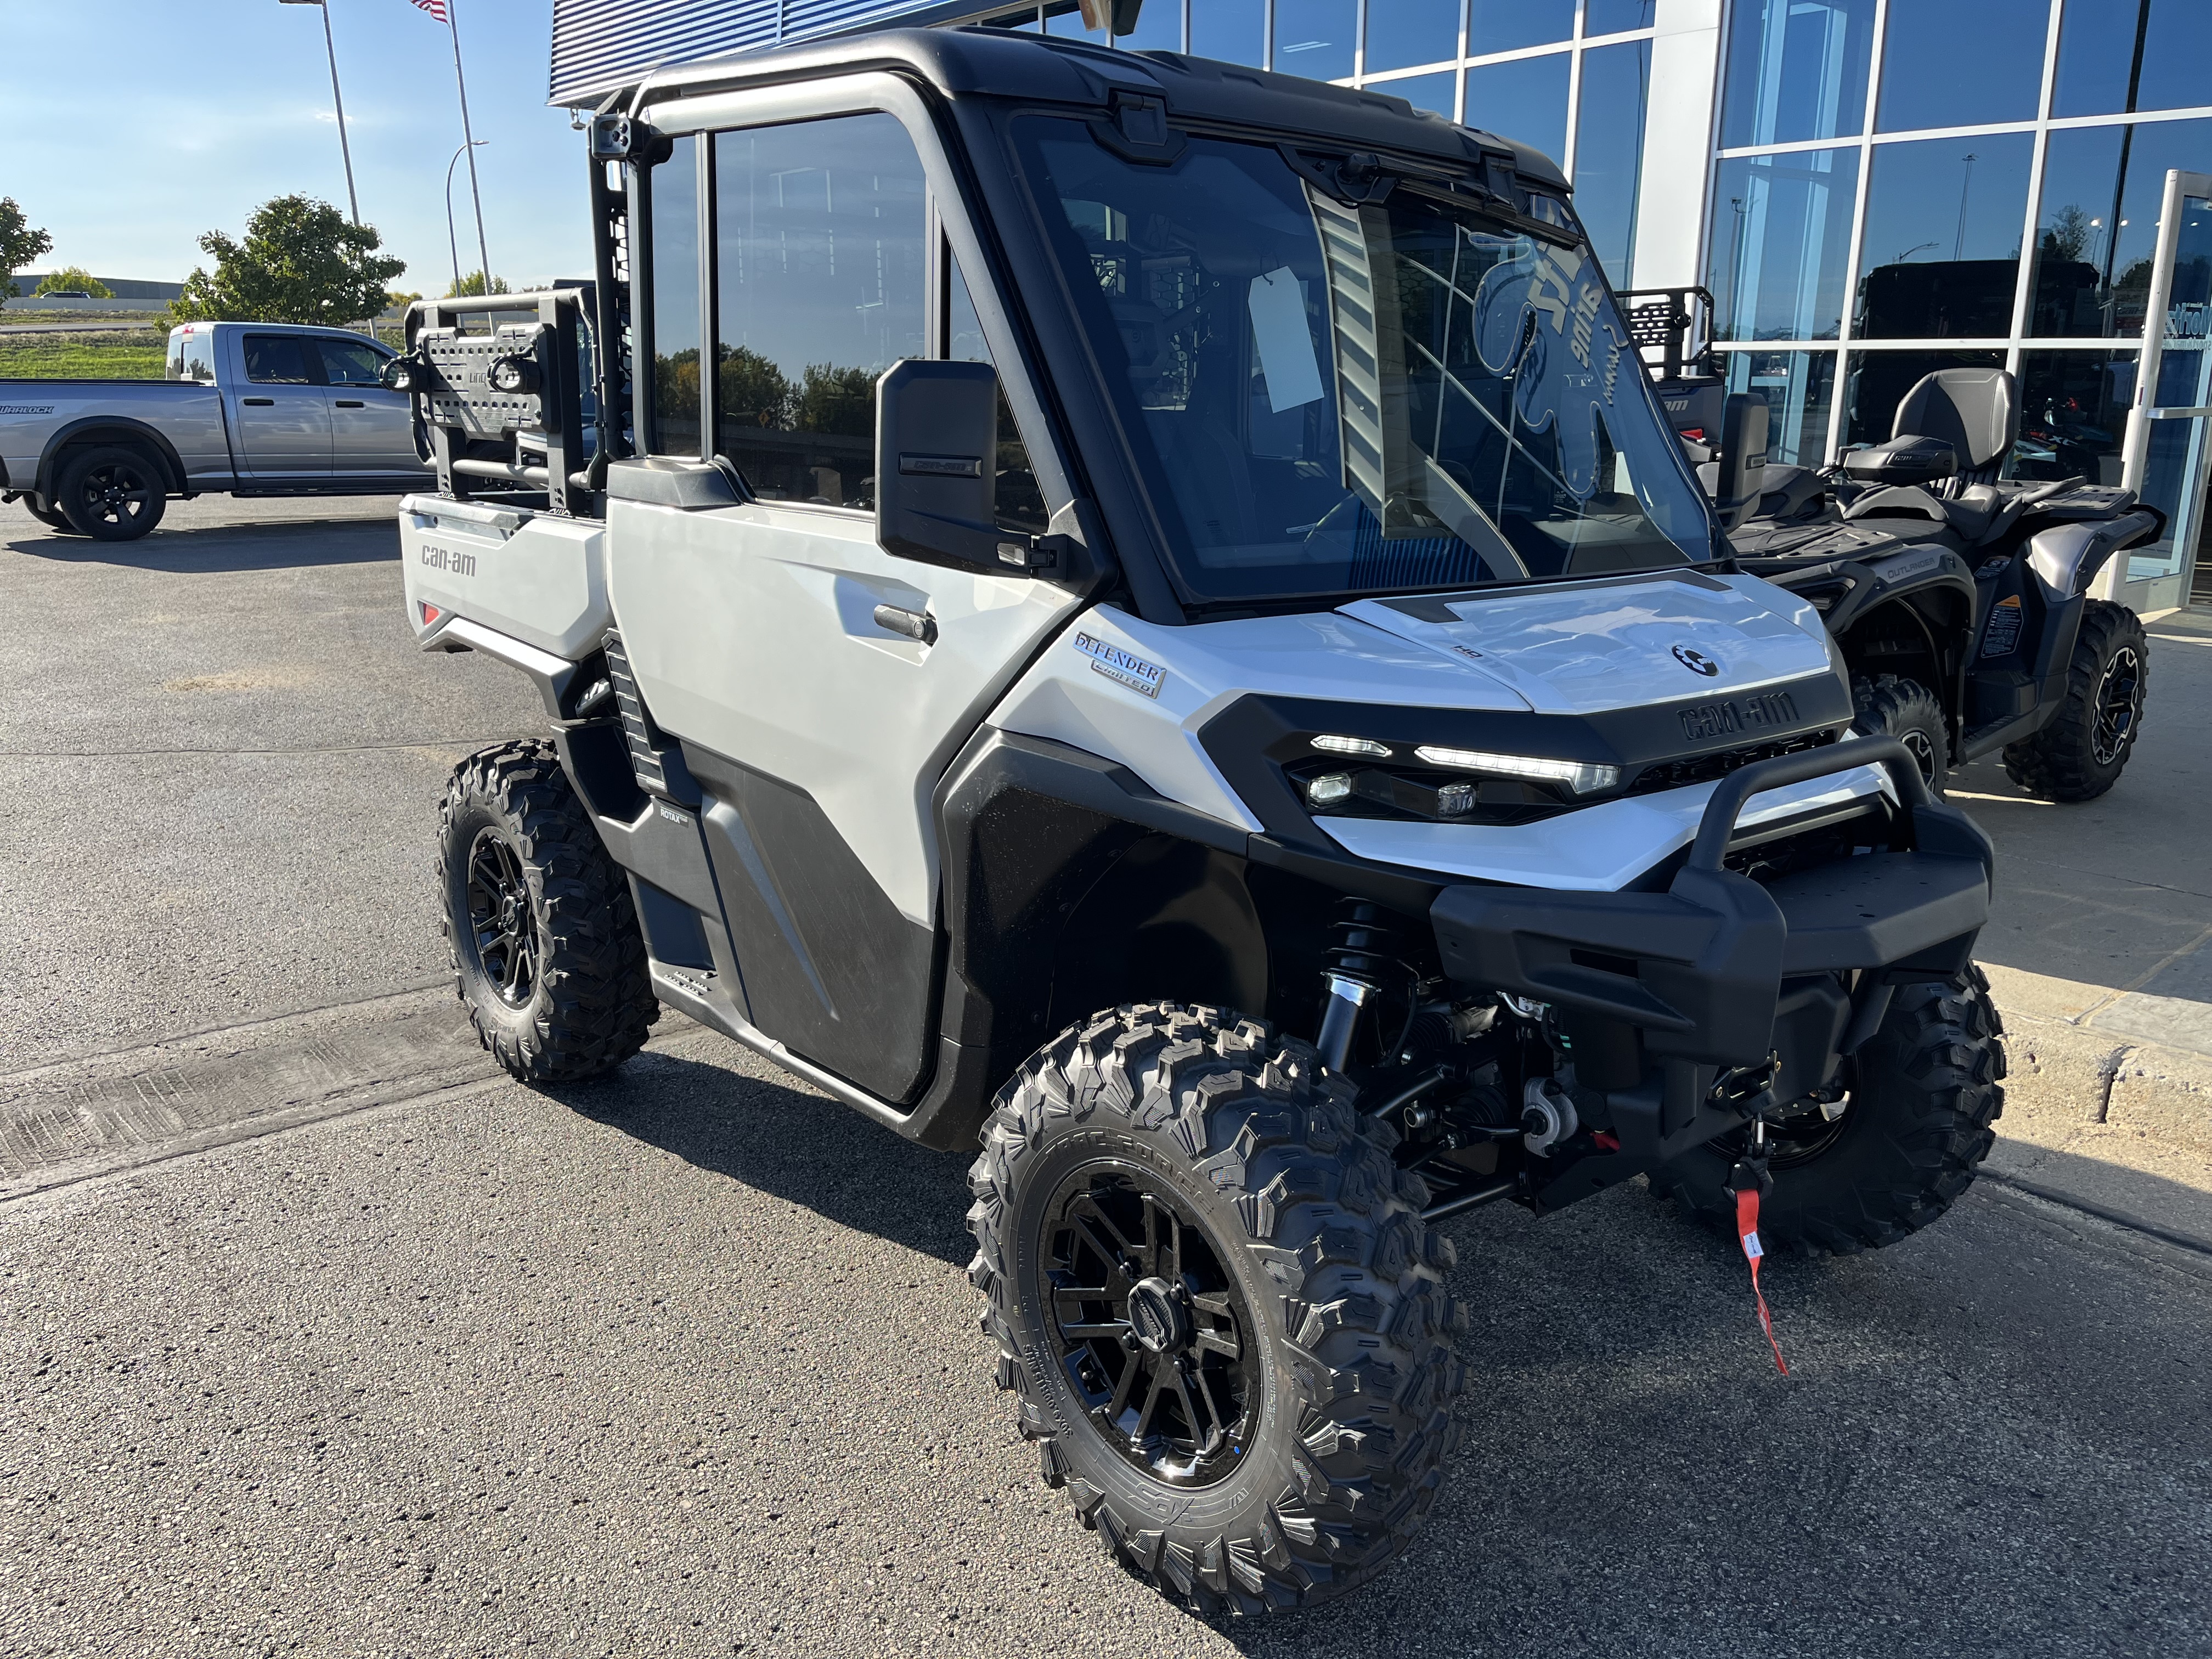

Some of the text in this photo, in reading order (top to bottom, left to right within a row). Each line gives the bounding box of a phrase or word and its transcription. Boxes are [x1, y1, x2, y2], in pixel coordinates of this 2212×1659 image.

[421, 544, 476, 577] can-am
[1887, 557, 1936, 579] OUTLANDER
[1075, 633, 1159, 681] DEFENDER
[1677, 691, 1801, 742] can-am
[660, 808, 680, 824] ROTAX
[1117, 1134, 1214, 1215] FORCE
